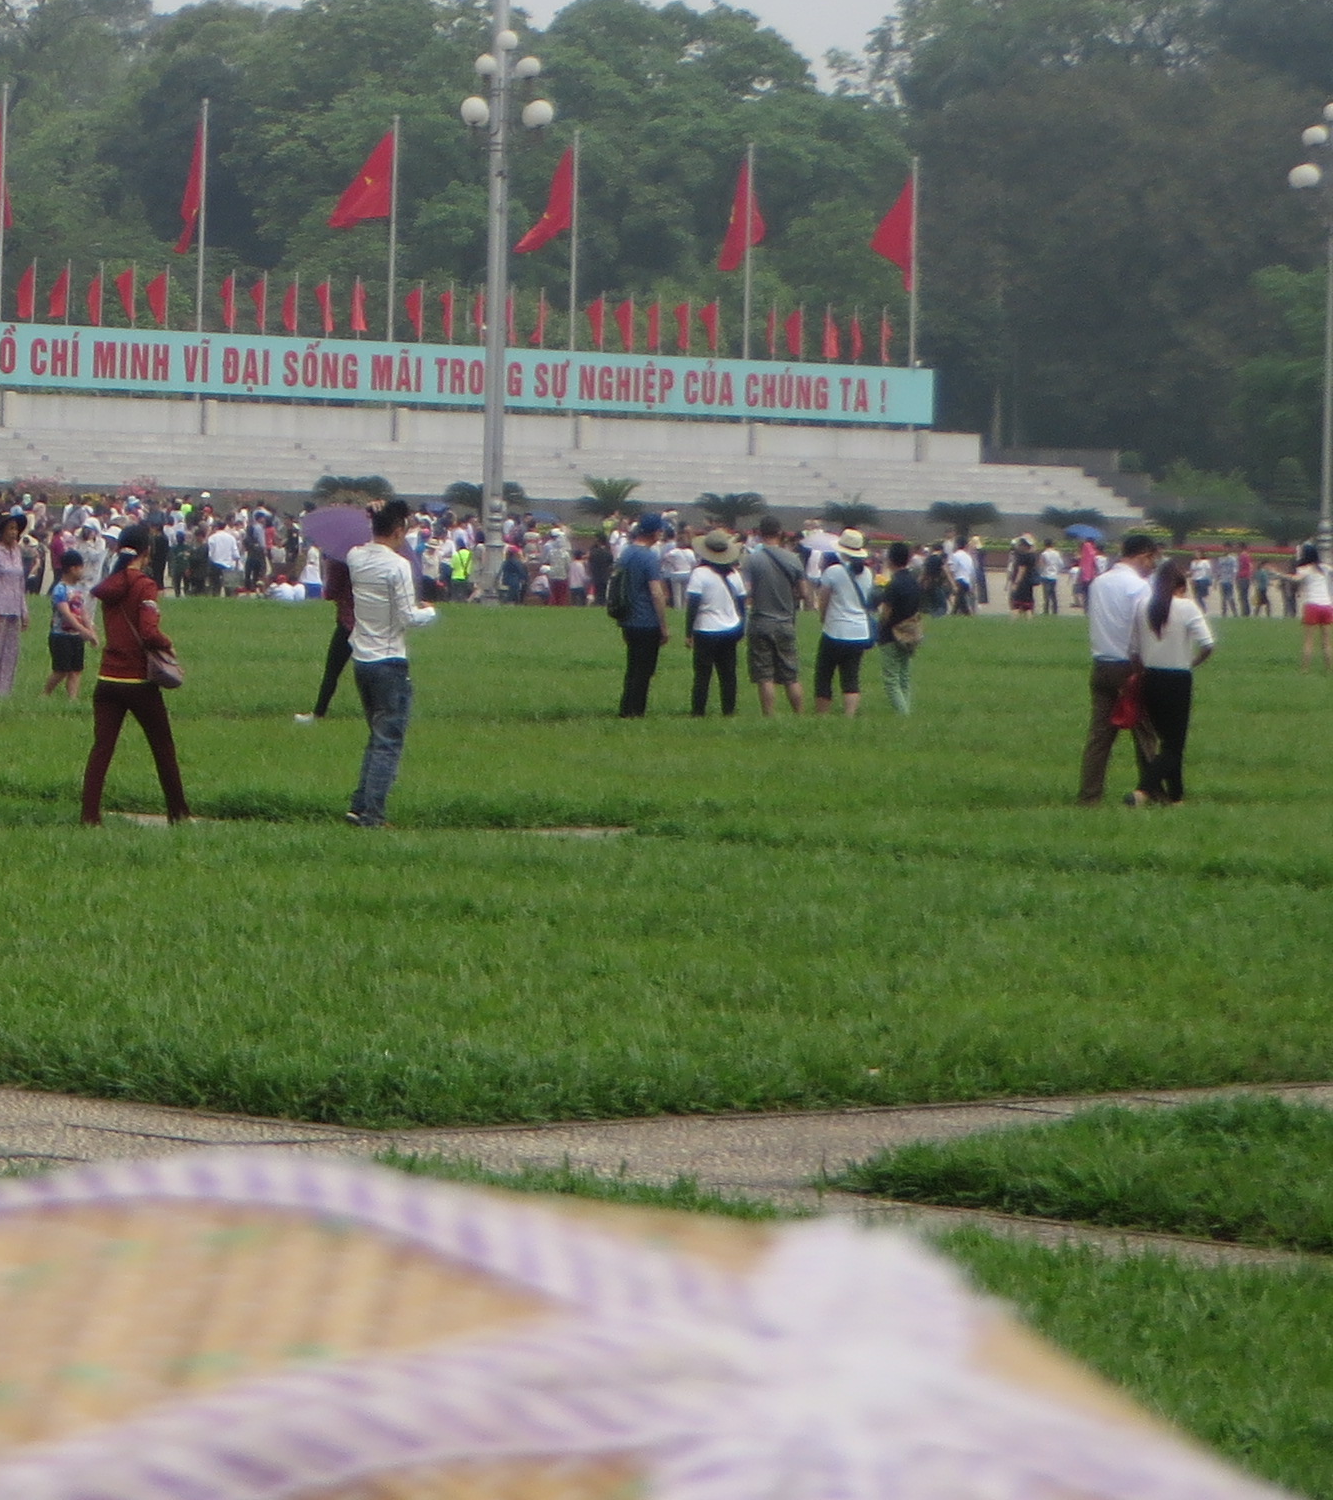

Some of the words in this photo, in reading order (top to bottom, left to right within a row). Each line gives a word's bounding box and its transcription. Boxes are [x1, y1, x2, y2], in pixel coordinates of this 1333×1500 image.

[30, 331, 81, 377] CHÍ
[92, 341, 170, 381] MINH
[183, 338, 211, 383] VĨ
[222, 347, 270, 393] ĐẠI
[282, 340, 359, 390] SỐNG
[370, 348, 422, 393] MÃI
[434, 357, 523, 397] TROG
[534, 358, 571, 406] SỰ
[578, 360, 675, 410] NGHIỆP
[684, 359, 734, 406] CỦA
[745, 366, 830, 412] CHÚNG
[839, 377, 870, 413] TA
